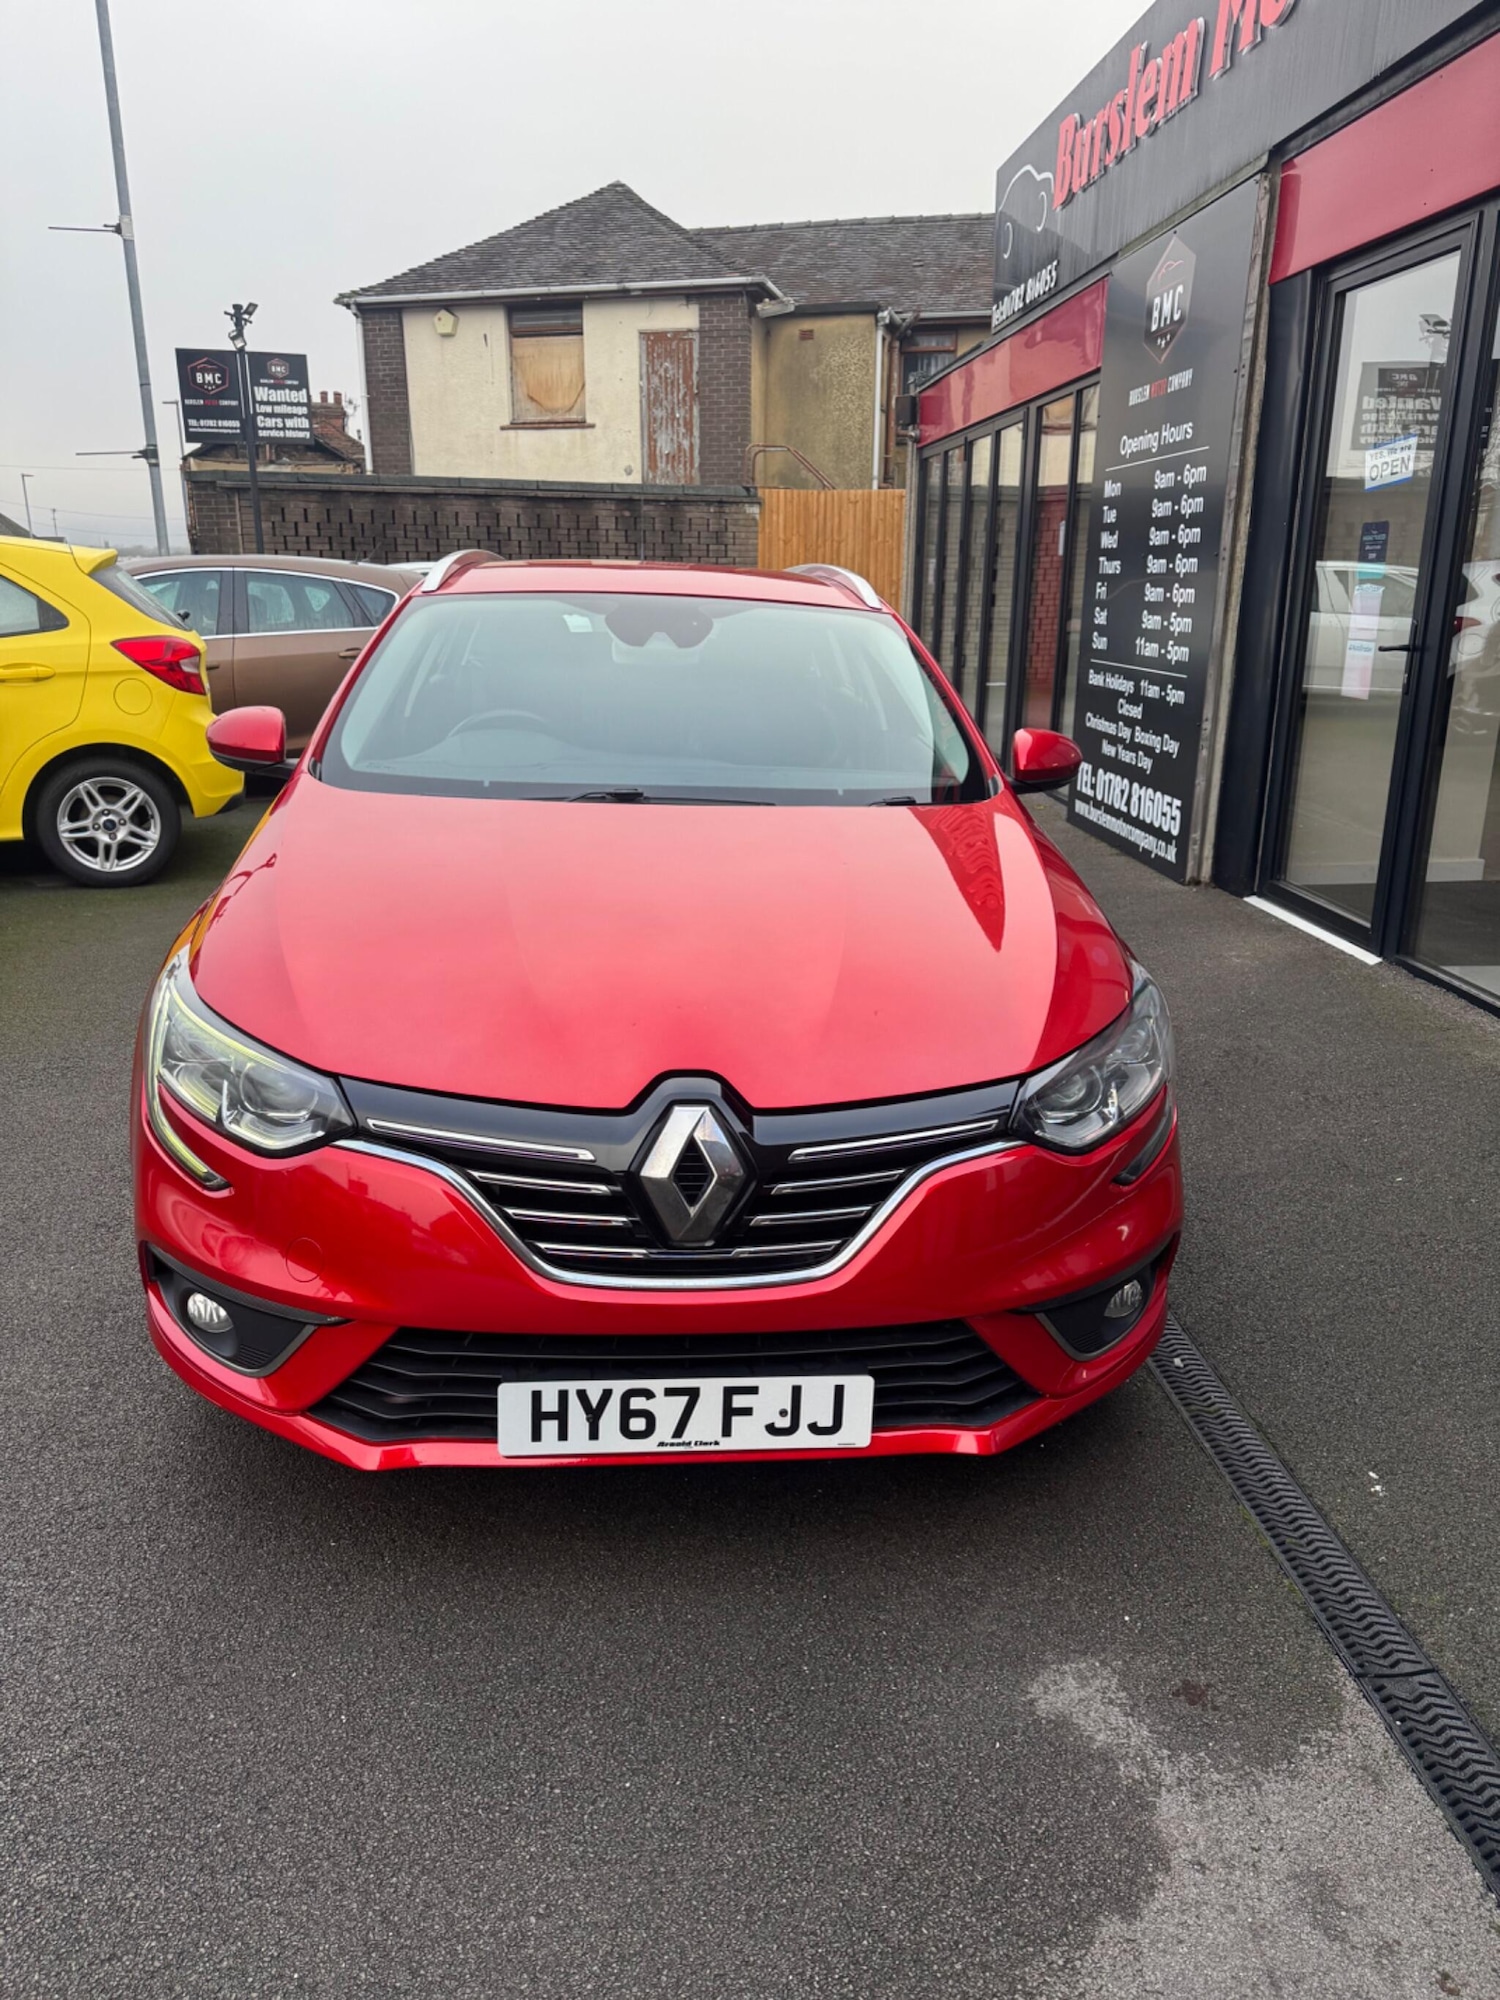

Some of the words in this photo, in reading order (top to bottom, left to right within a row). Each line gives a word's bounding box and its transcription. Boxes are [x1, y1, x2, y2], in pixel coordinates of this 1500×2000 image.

[1053, 17, 1203, 211] Burslem
[1150, 284, 1184, 333] BMC
[195, 372, 222, 385] BMC
[270, 365, 287, 374] BMC
[253, 386, 308, 403] Wanted
[255, 403, 273, 414] Low
[273, 404, 308, 416] mileage
[256, 415, 284, 428] Cars
[284, 416, 310, 429] with
[257, 429, 284, 438] service
[285, 429, 311, 439] history
[1120, 429, 1159, 459] Opening
[1160, 421, 1193, 445] Hours
[1103, 479, 1121, 498] Mon
[1154, 469, 1175, 490] 9am
[1183, 463, 1207, 489] 6pm
[1369, 455, 1411, 481] OPEN
[1102, 505, 1117, 524] Tue
[1151, 498, 1172, 518] 9am
[1180, 494, 1204, 519] 6pm
[1100, 530, 1119, 549] Wed
[1148, 526, 1170, 546] 9am
[1177, 523, 1201, 549] 6pm
[1098, 556, 1121, 574] Thurs
[1146, 554, 1167, 574] 9am
[1174, 552, 1198, 578] 6pm
[1095, 581, 1107, 600] Fri
[1144, 582, 1165, 602] 9am
[1171, 582, 1195, 608] 6pm
[1093, 606, 1107, 625] Sat
[1141, 609, 1162, 630] 9am
[1169, 612, 1192, 637] 5pm
[1092, 631, 1108, 650] Sun
[1135, 636, 1159, 658] 11am
[1166, 640, 1190, 665] 5pm
[1088, 668, 1105, 688] Bank
[1105, 671, 1135, 697] Holidays
[1140, 679, 1161, 699] 11am
[1165, 684, 1185, 707] 5pm
[1117, 698, 1143, 720] Closed
[1085, 711, 1117, 736] Christmas
[1117, 721, 1133, 744] Day
[1134, 725, 1162, 754] Boxing
[1162, 733, 1180, 759] Day
[1101, 738, 1117, 758] New
[1117, 743, 1137, 766] Years
[1137, 750, 1154, 775] Day
[1095, 767, 1130, 813] 01782
[1129, 782, 1182, 836] 816055
[530, 1387, 701, 1442] HY67
[721, 1384, 845, 1437] FJJ
